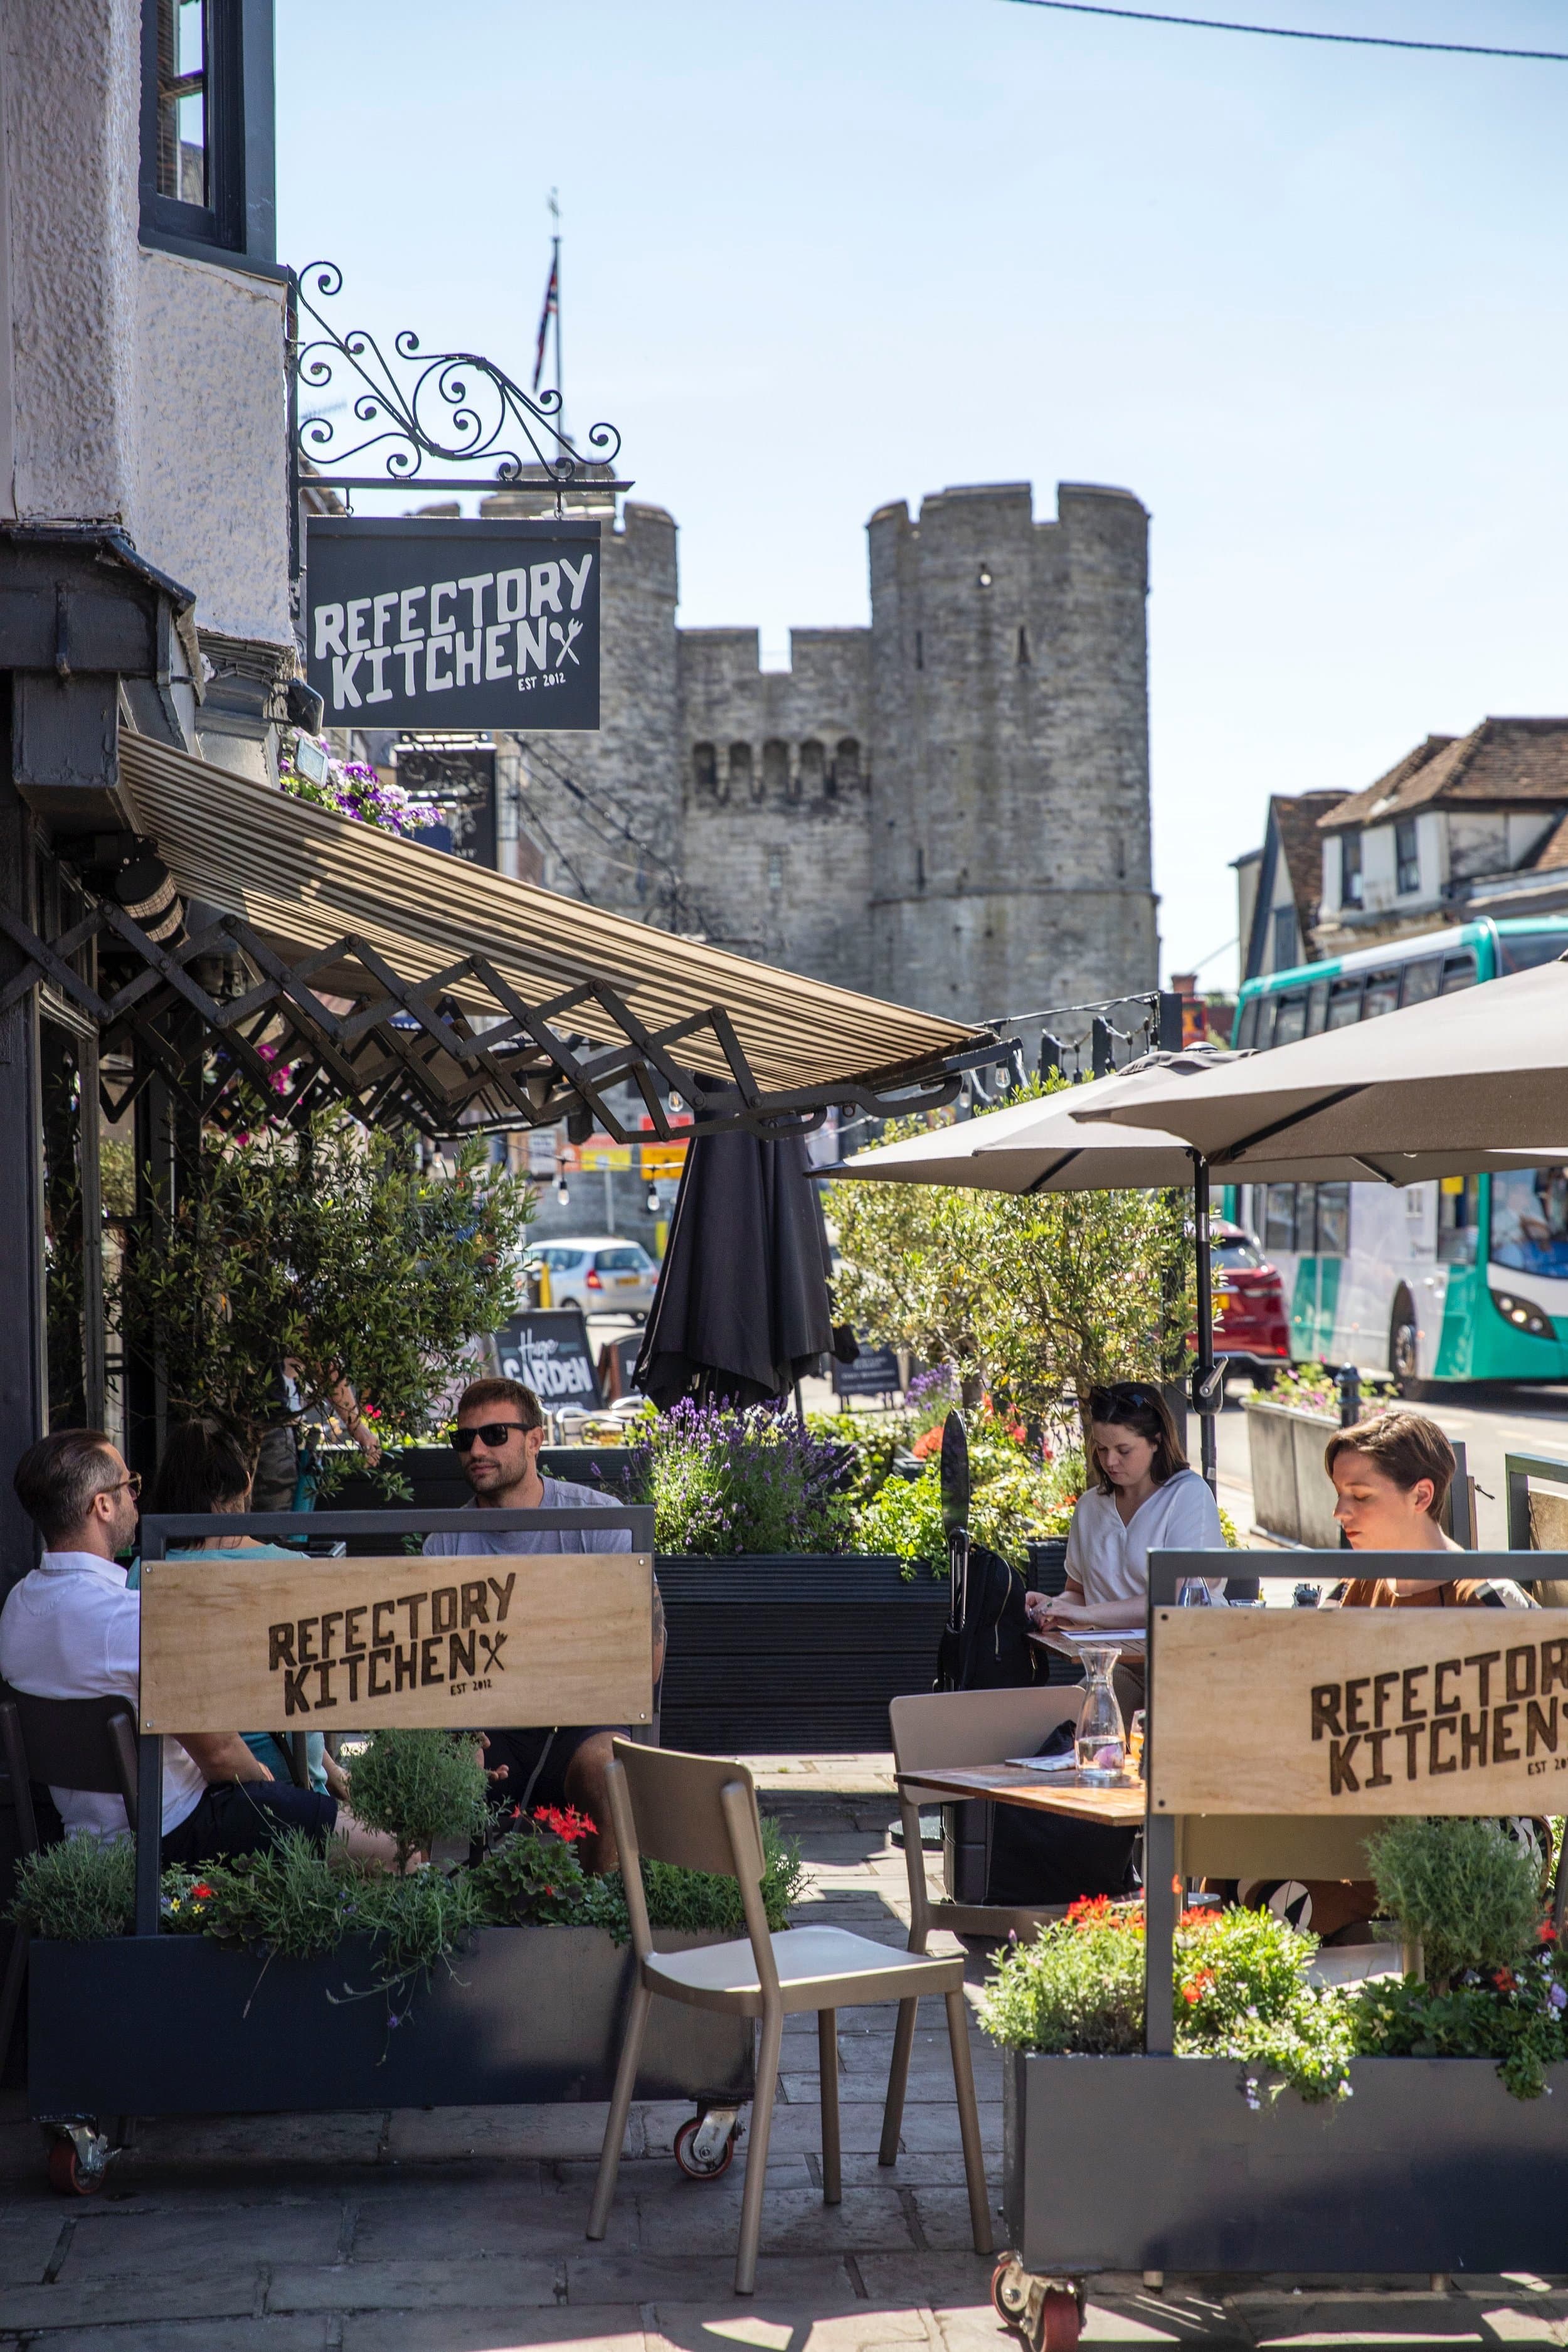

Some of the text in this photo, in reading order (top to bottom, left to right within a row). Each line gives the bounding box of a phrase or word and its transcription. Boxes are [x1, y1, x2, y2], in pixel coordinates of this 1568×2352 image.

[314, 553, 593, 662] REFECTORY
[332, 615, 548, 710] KITCHEN
[517, 672, 566, 691] EST 2012
[502, 1356, 593, 1397] GARDEN
[268, 1572, 516, 1672] REFECTORY
[283, 1629, 476, 1717] KITCHEN
[450, 1678, 492, 1696] EST 2012
[1310, 1637, 1568, 1741] REFECTOR
[1329, 1696, 1559, 1796] KITCHEN
[1527, 1760, 1547, 1775] EST
